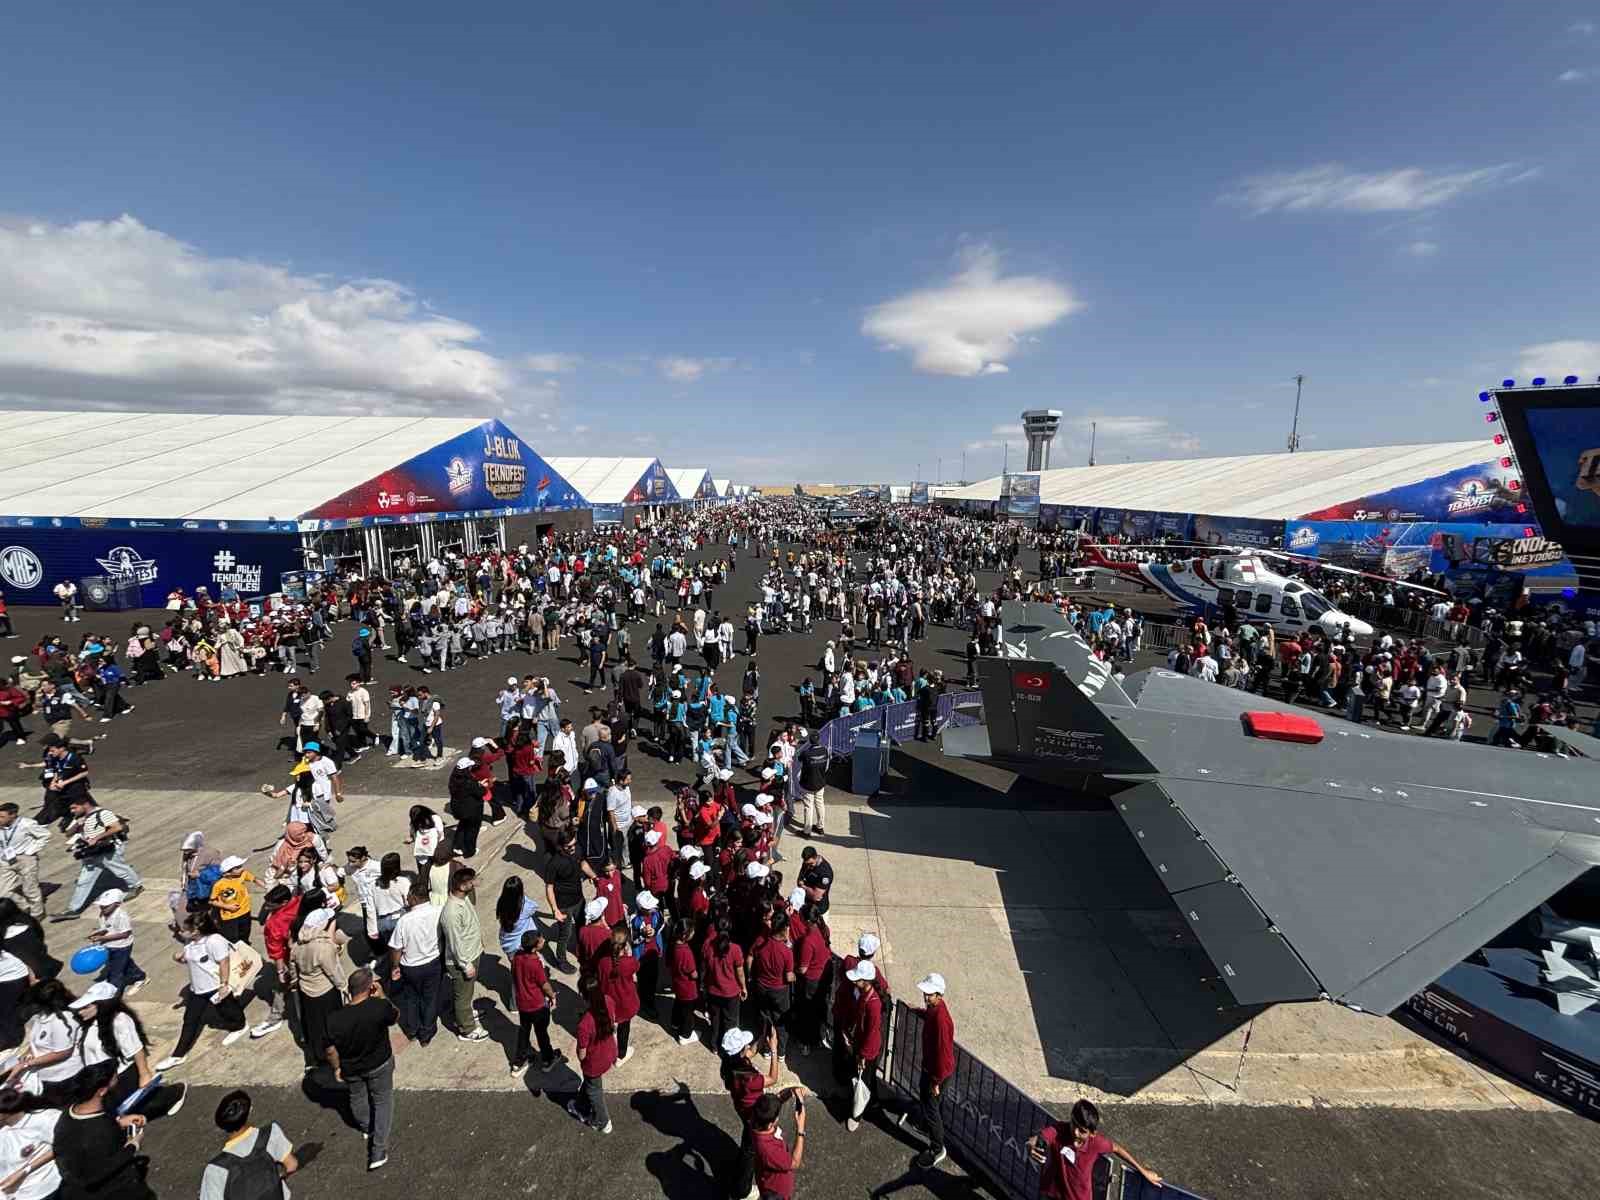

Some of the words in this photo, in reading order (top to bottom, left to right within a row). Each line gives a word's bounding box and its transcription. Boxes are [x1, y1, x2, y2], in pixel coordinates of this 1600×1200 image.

[483, 434, 521, 460] J-BLOK
[482, 463, 527, 482] TEKNOFEST
[1447, 494, 1495, 513] TEKNOFEST
[3, 550, 37, 584] MKE
